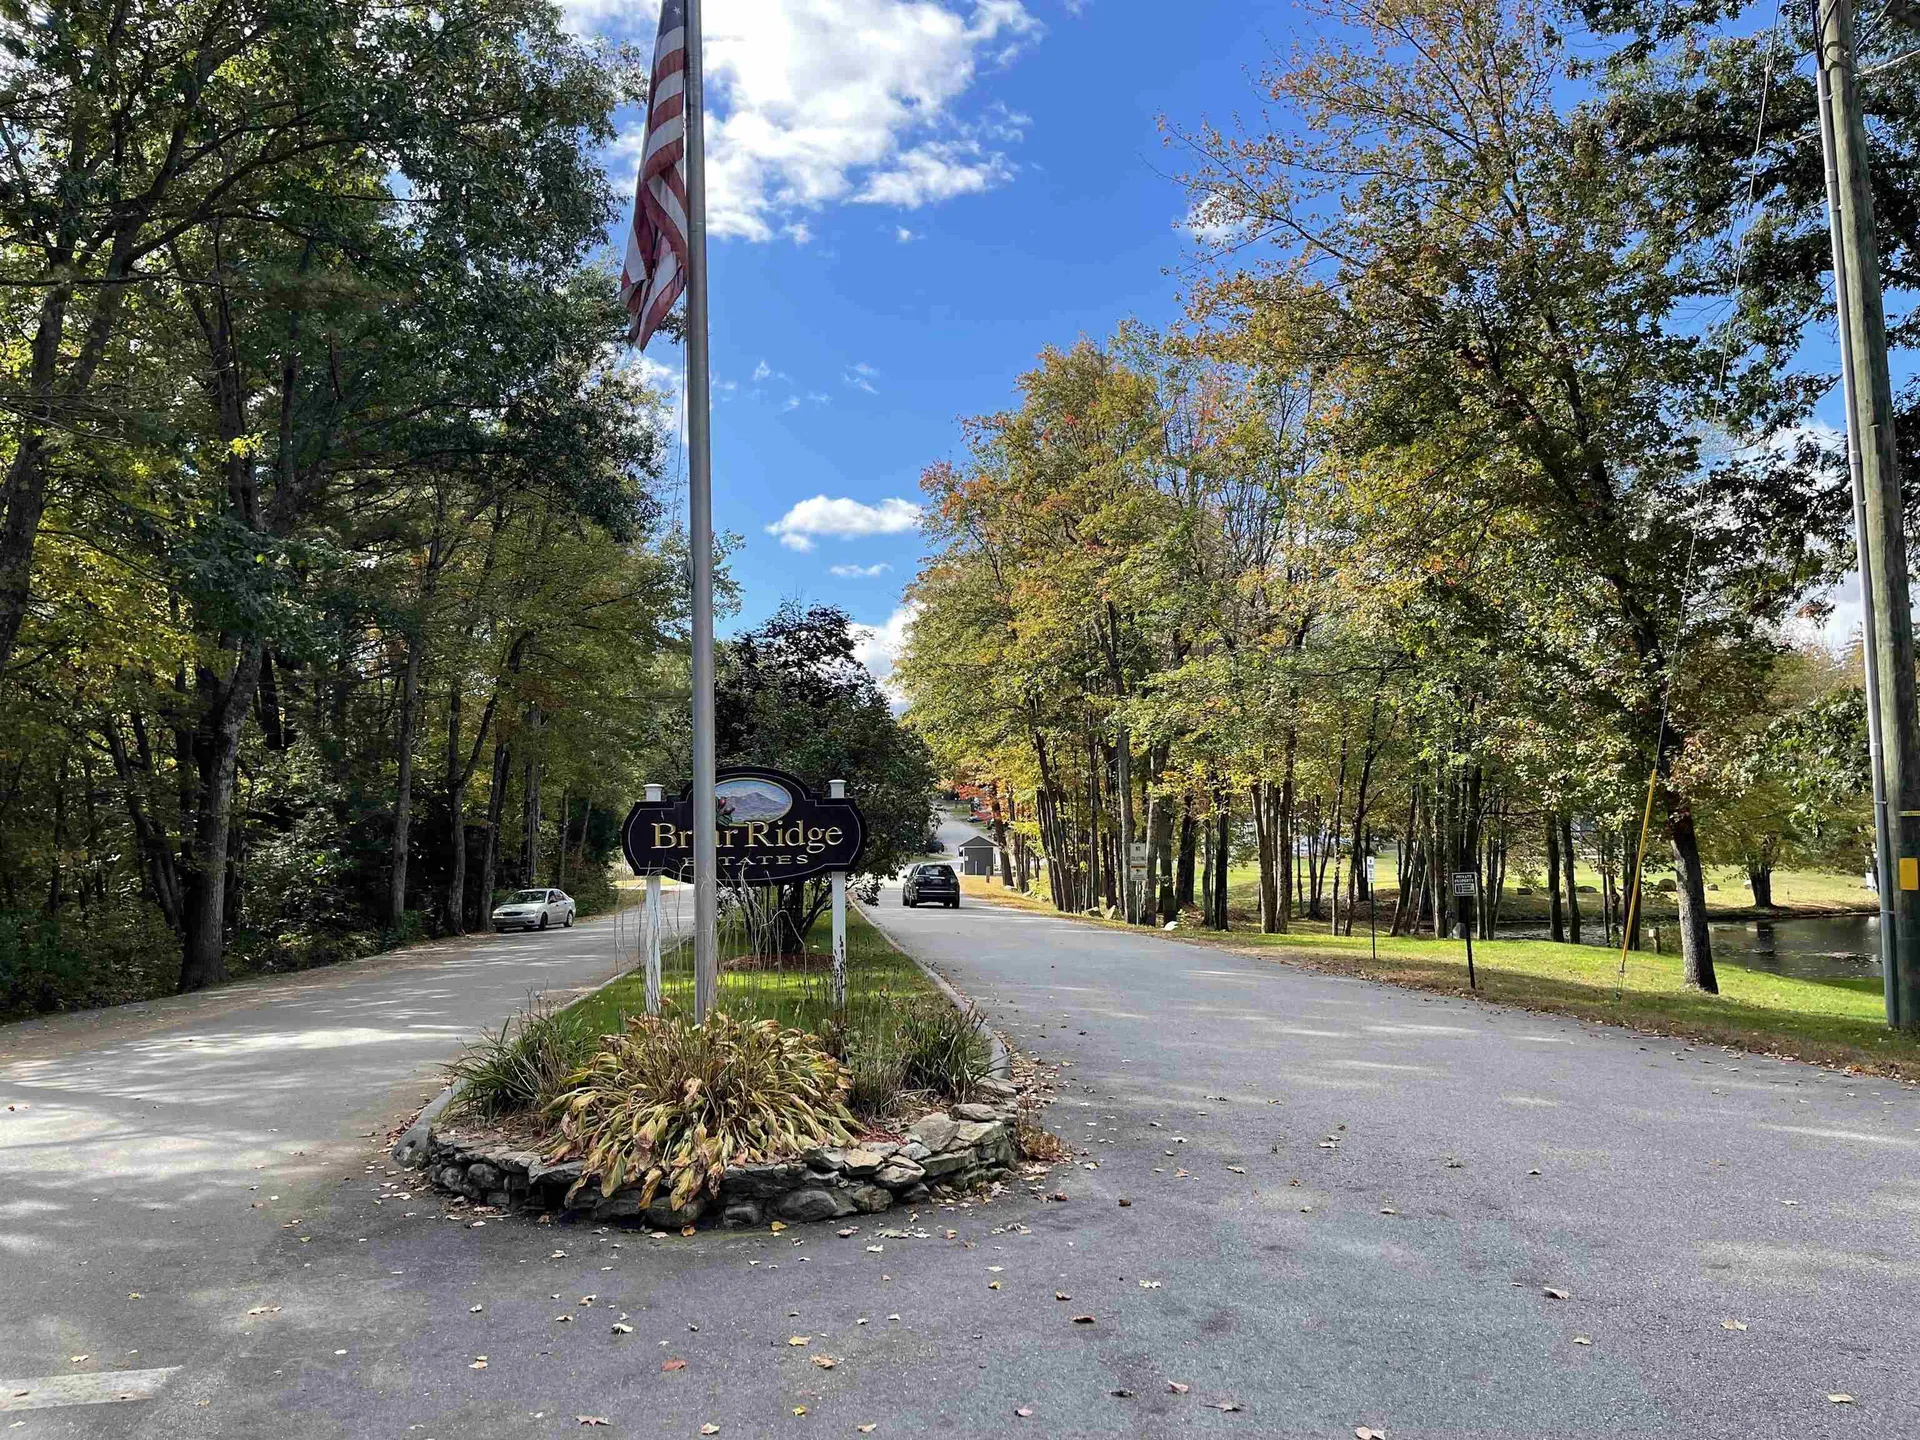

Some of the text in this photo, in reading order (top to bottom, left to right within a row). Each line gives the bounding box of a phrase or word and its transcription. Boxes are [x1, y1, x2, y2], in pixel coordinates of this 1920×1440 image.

[651, 820, 844, 854] Brr Ridge
[682, 854, 809, 866] ETATES
